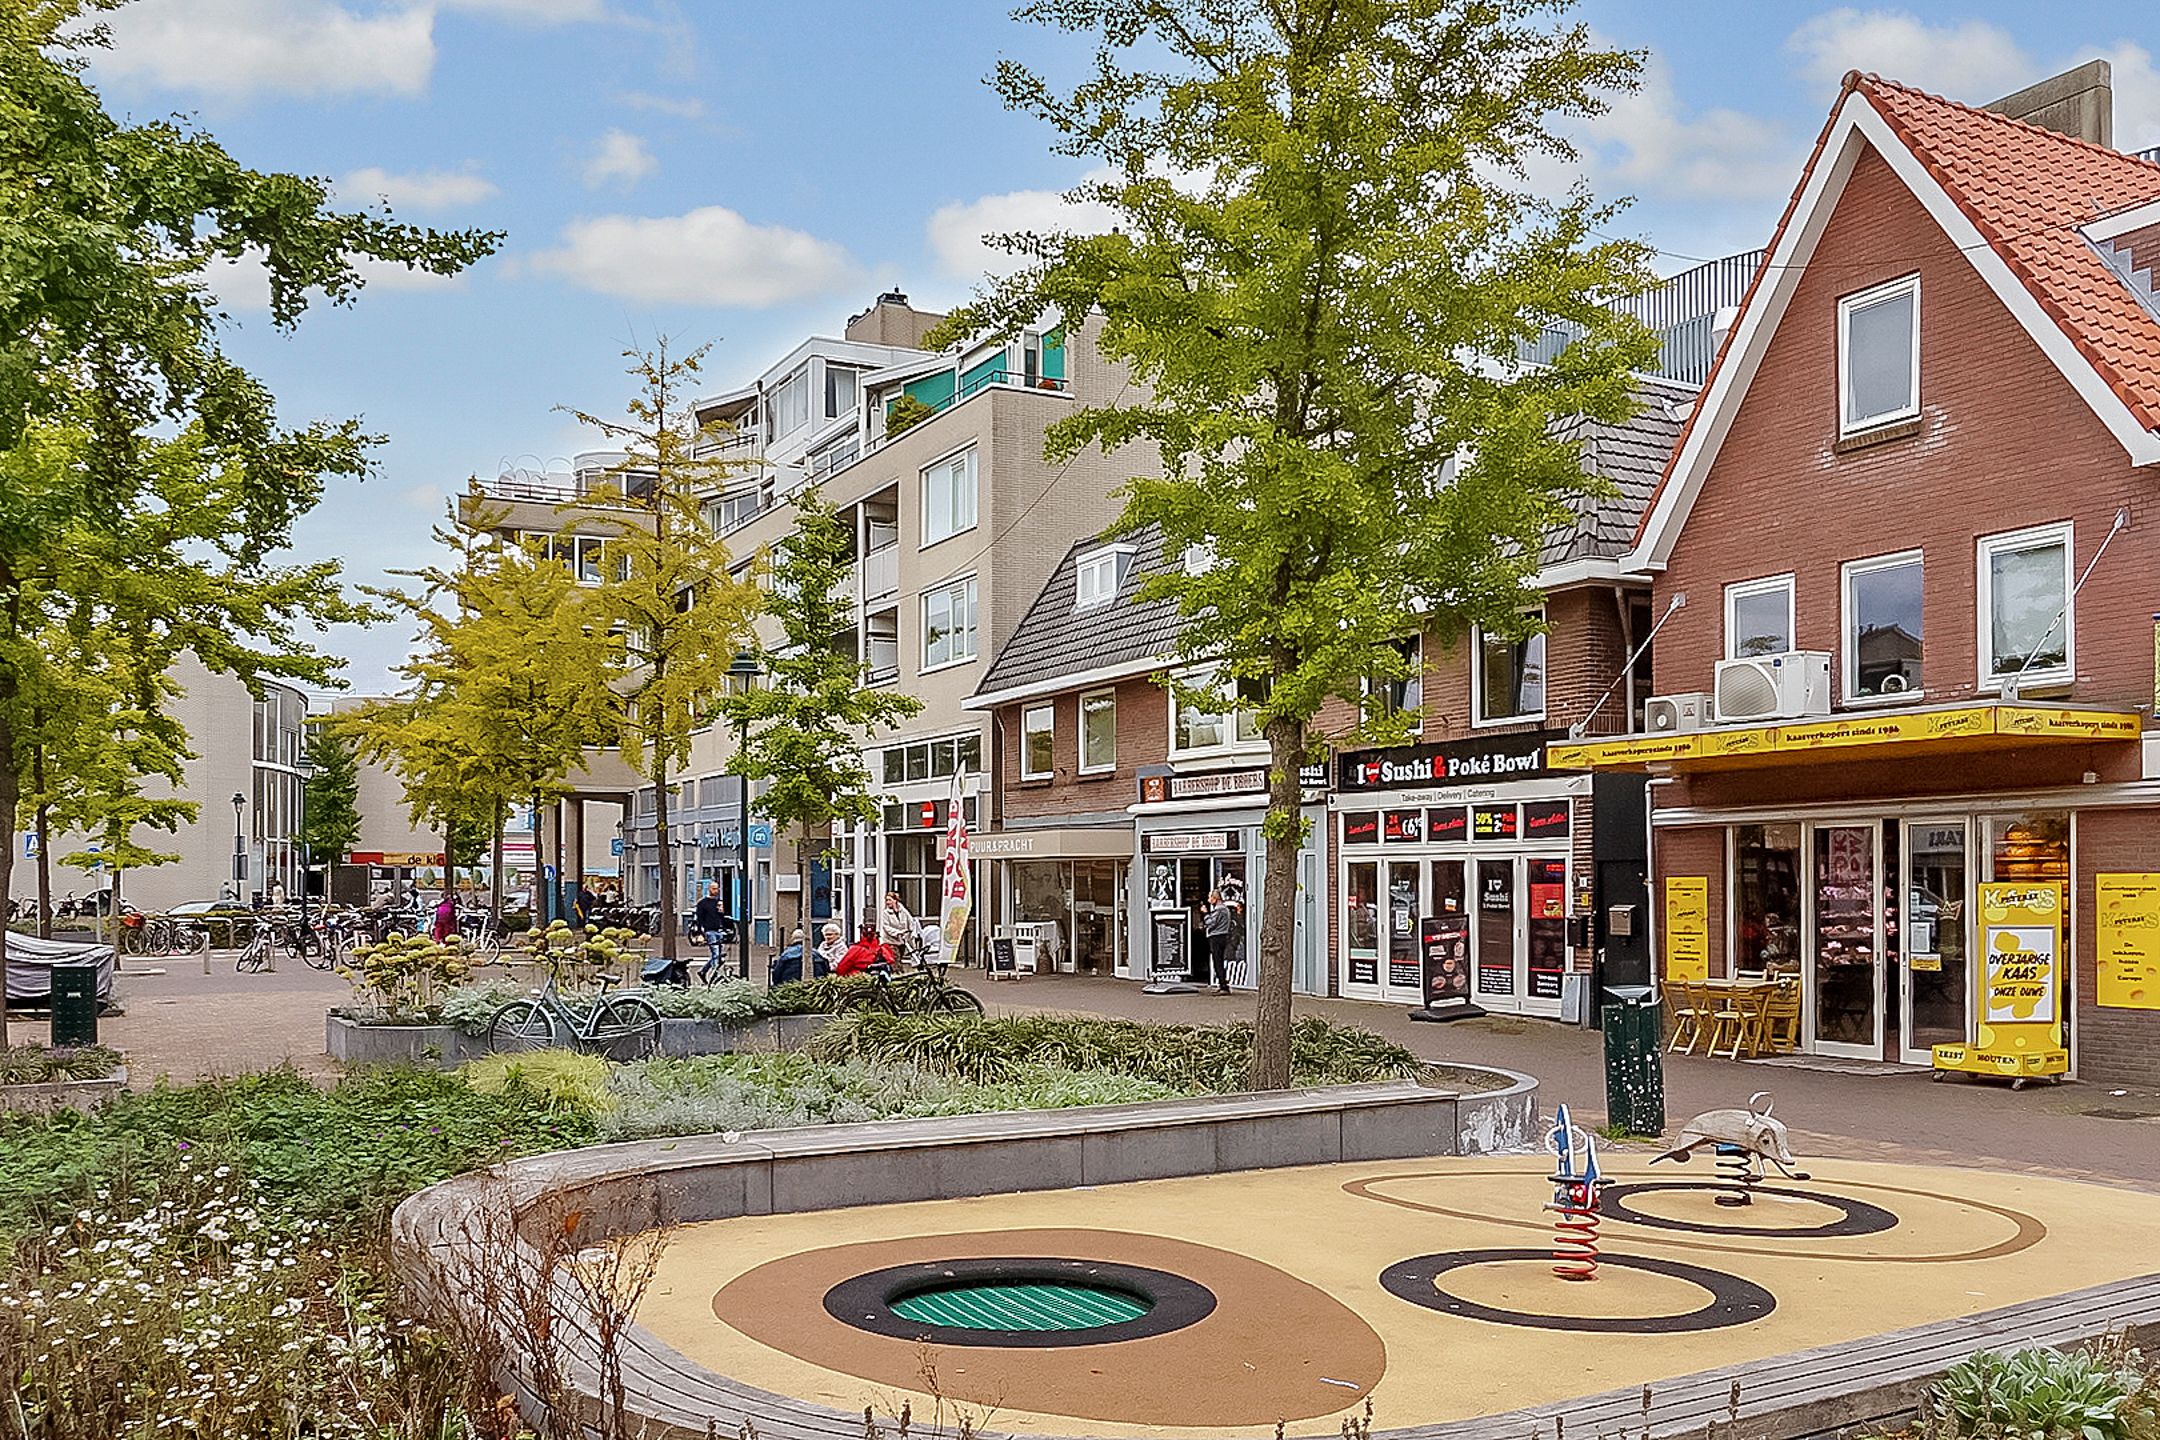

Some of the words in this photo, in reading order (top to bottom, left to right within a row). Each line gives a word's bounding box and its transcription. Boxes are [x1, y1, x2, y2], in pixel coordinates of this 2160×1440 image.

[1786, 730, 1850, 742] kaasverkopers
[1851, 727, 1875, 737] sinds
[1877, 725, 1900, 735] 1986
[1357, 764, 1366, 784] I
[1381, 758, 1433, 782] Sushi
[1434, 755, 1446, 778] &
[1448, 753, 1490, 777] Poké
[1492, 748, 1540, 773] Bowl
[1173, 776, 1220, 795] BARBERSHOP
[1234, 770, 1264, 789] BROERS
[1437, 790, 1463, 801] Delivery
[1467, 788, 1495, 798] Catering
[1475, 812, 1493, 825] 50%
[970, 838, 1034, 854] PUUR&PRACHT
[407, 855, 421, 865] de
[1989, 952, 2051, 966] OVERJARIGE
[2002, 966, 2038, 980] KAAS
[1994, 986, 2018, 997] ONZE
[1977, 1054, 2016, 1065] HOUTEN
